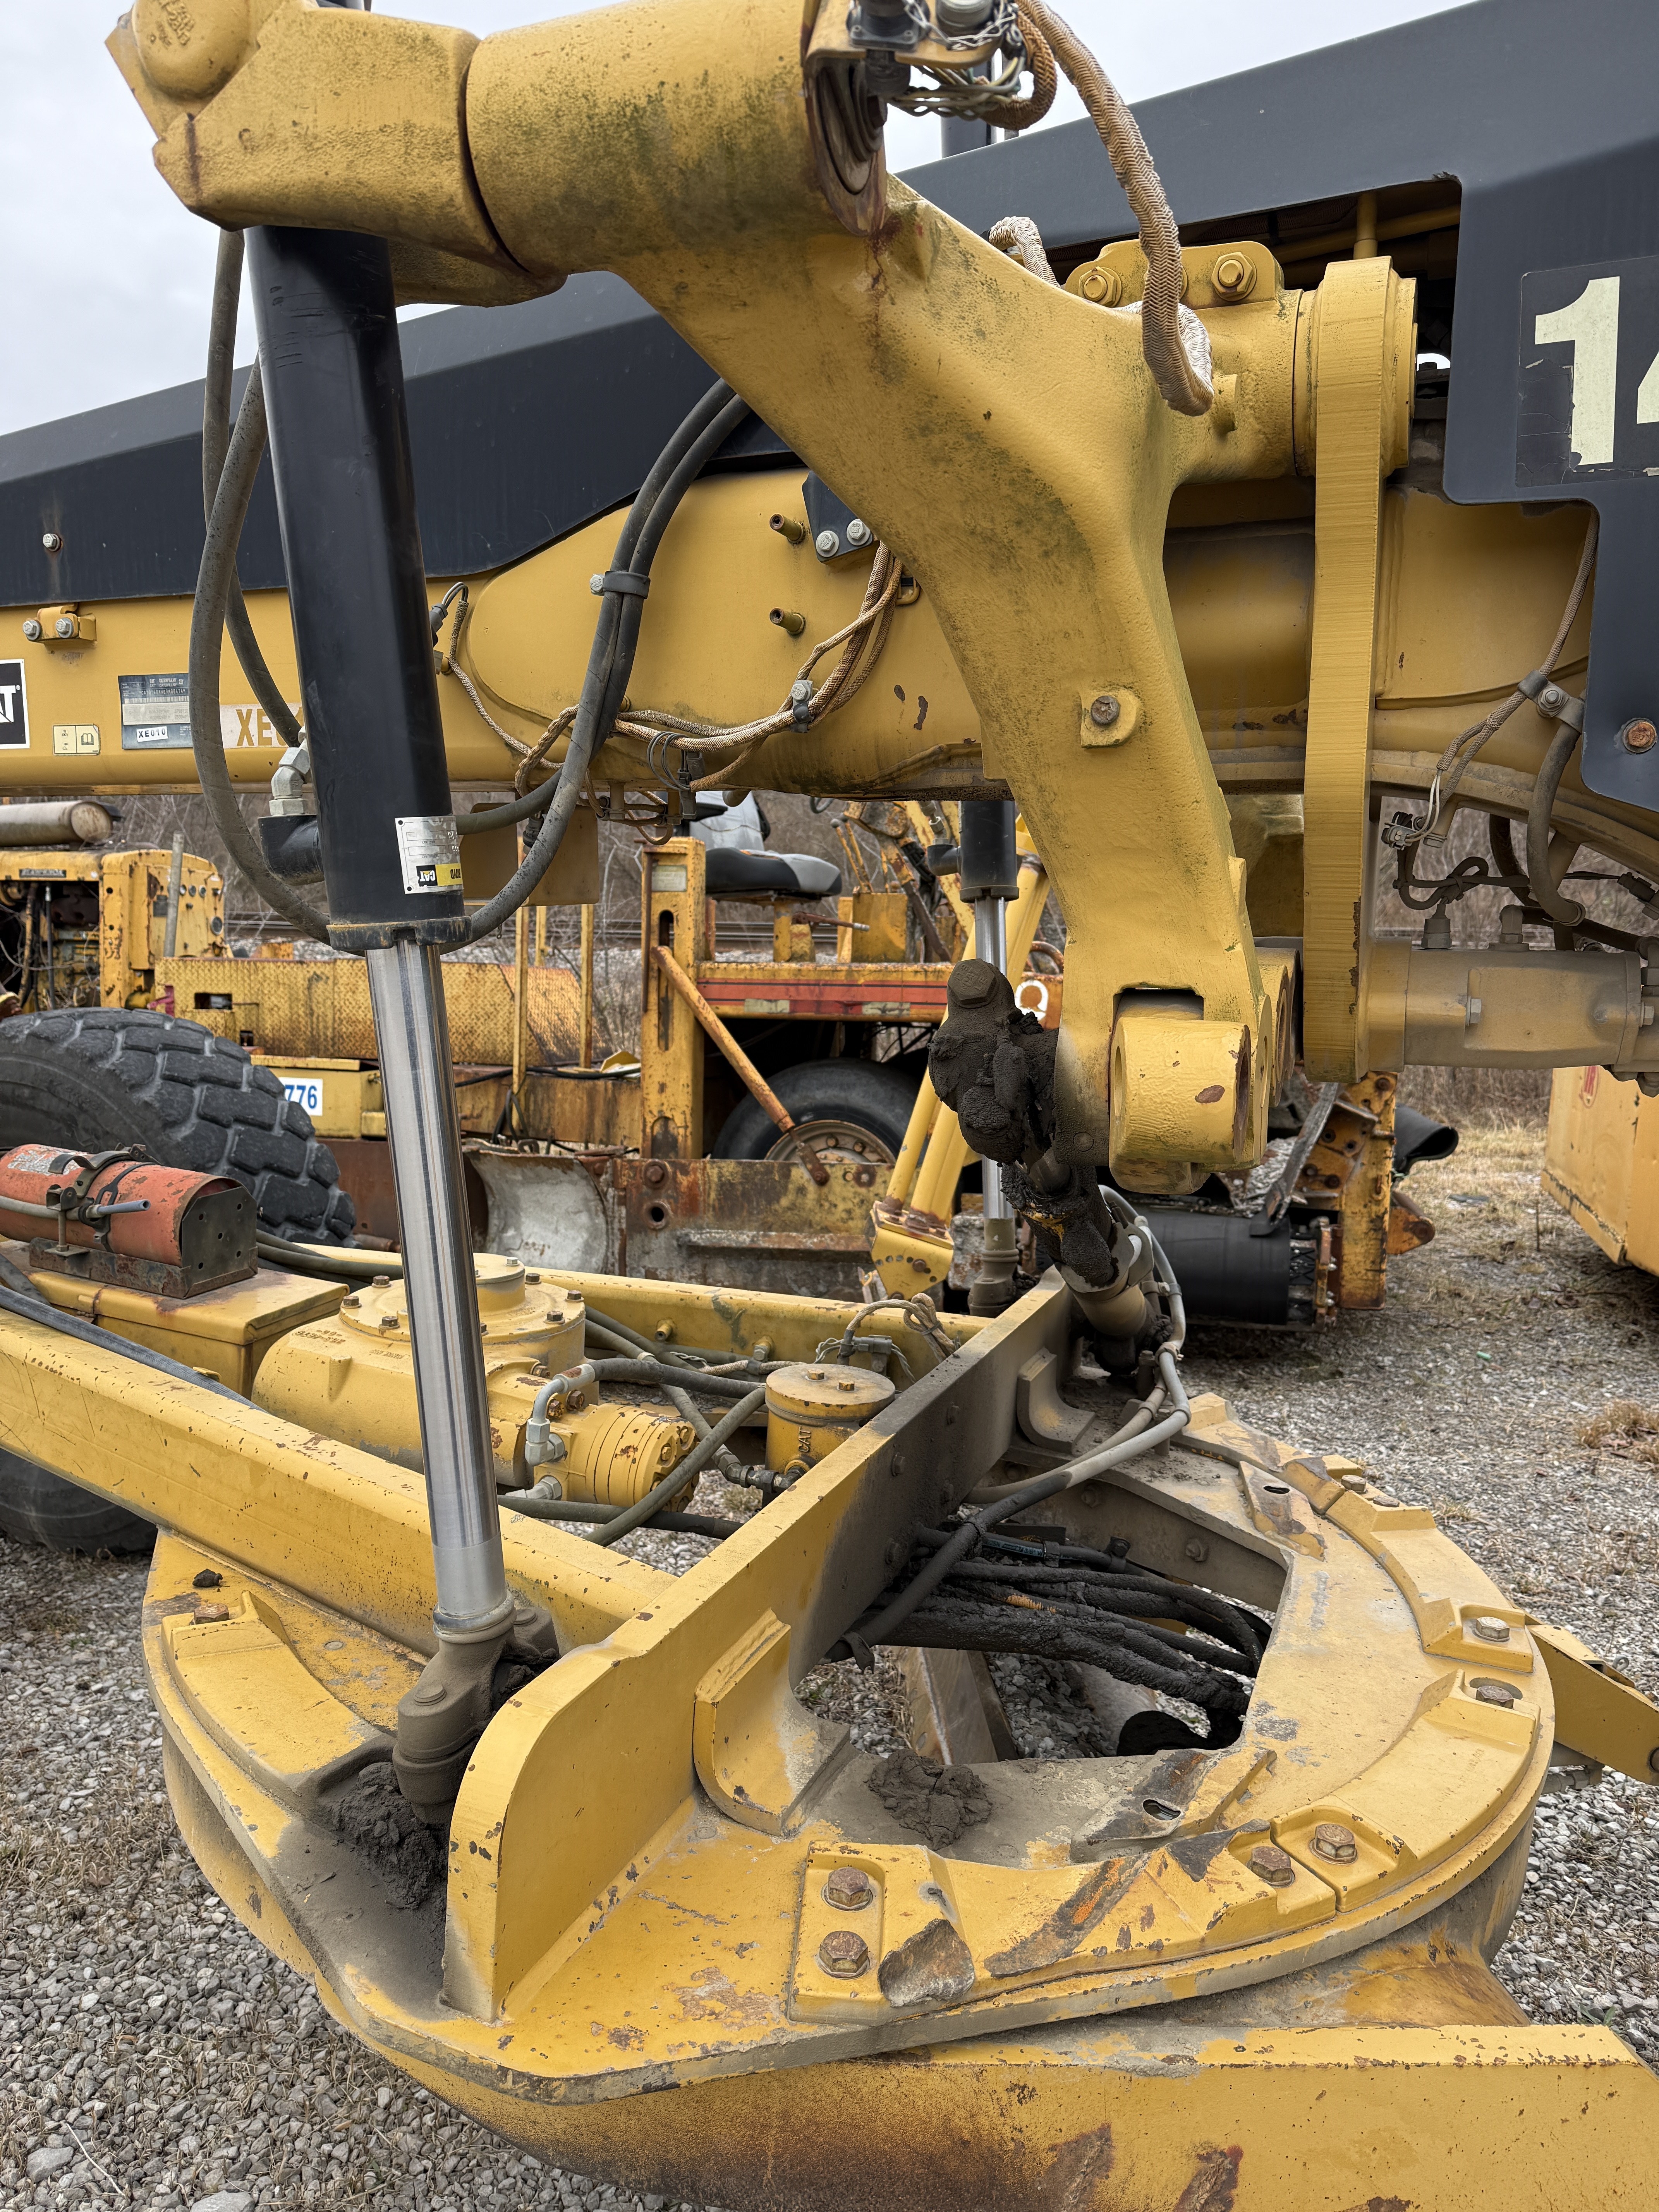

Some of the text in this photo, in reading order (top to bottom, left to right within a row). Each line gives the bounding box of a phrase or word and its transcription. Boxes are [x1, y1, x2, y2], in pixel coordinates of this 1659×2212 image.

[1535, 276, 1659, 465] 1
[0, 685, 16, 723] T
[139, 728, 166, 738] XE010
[420, 870, 436, 882] CAT
[285, 1085, 317, 1109] 776
[798, 1426, 811, 1453] CAT
